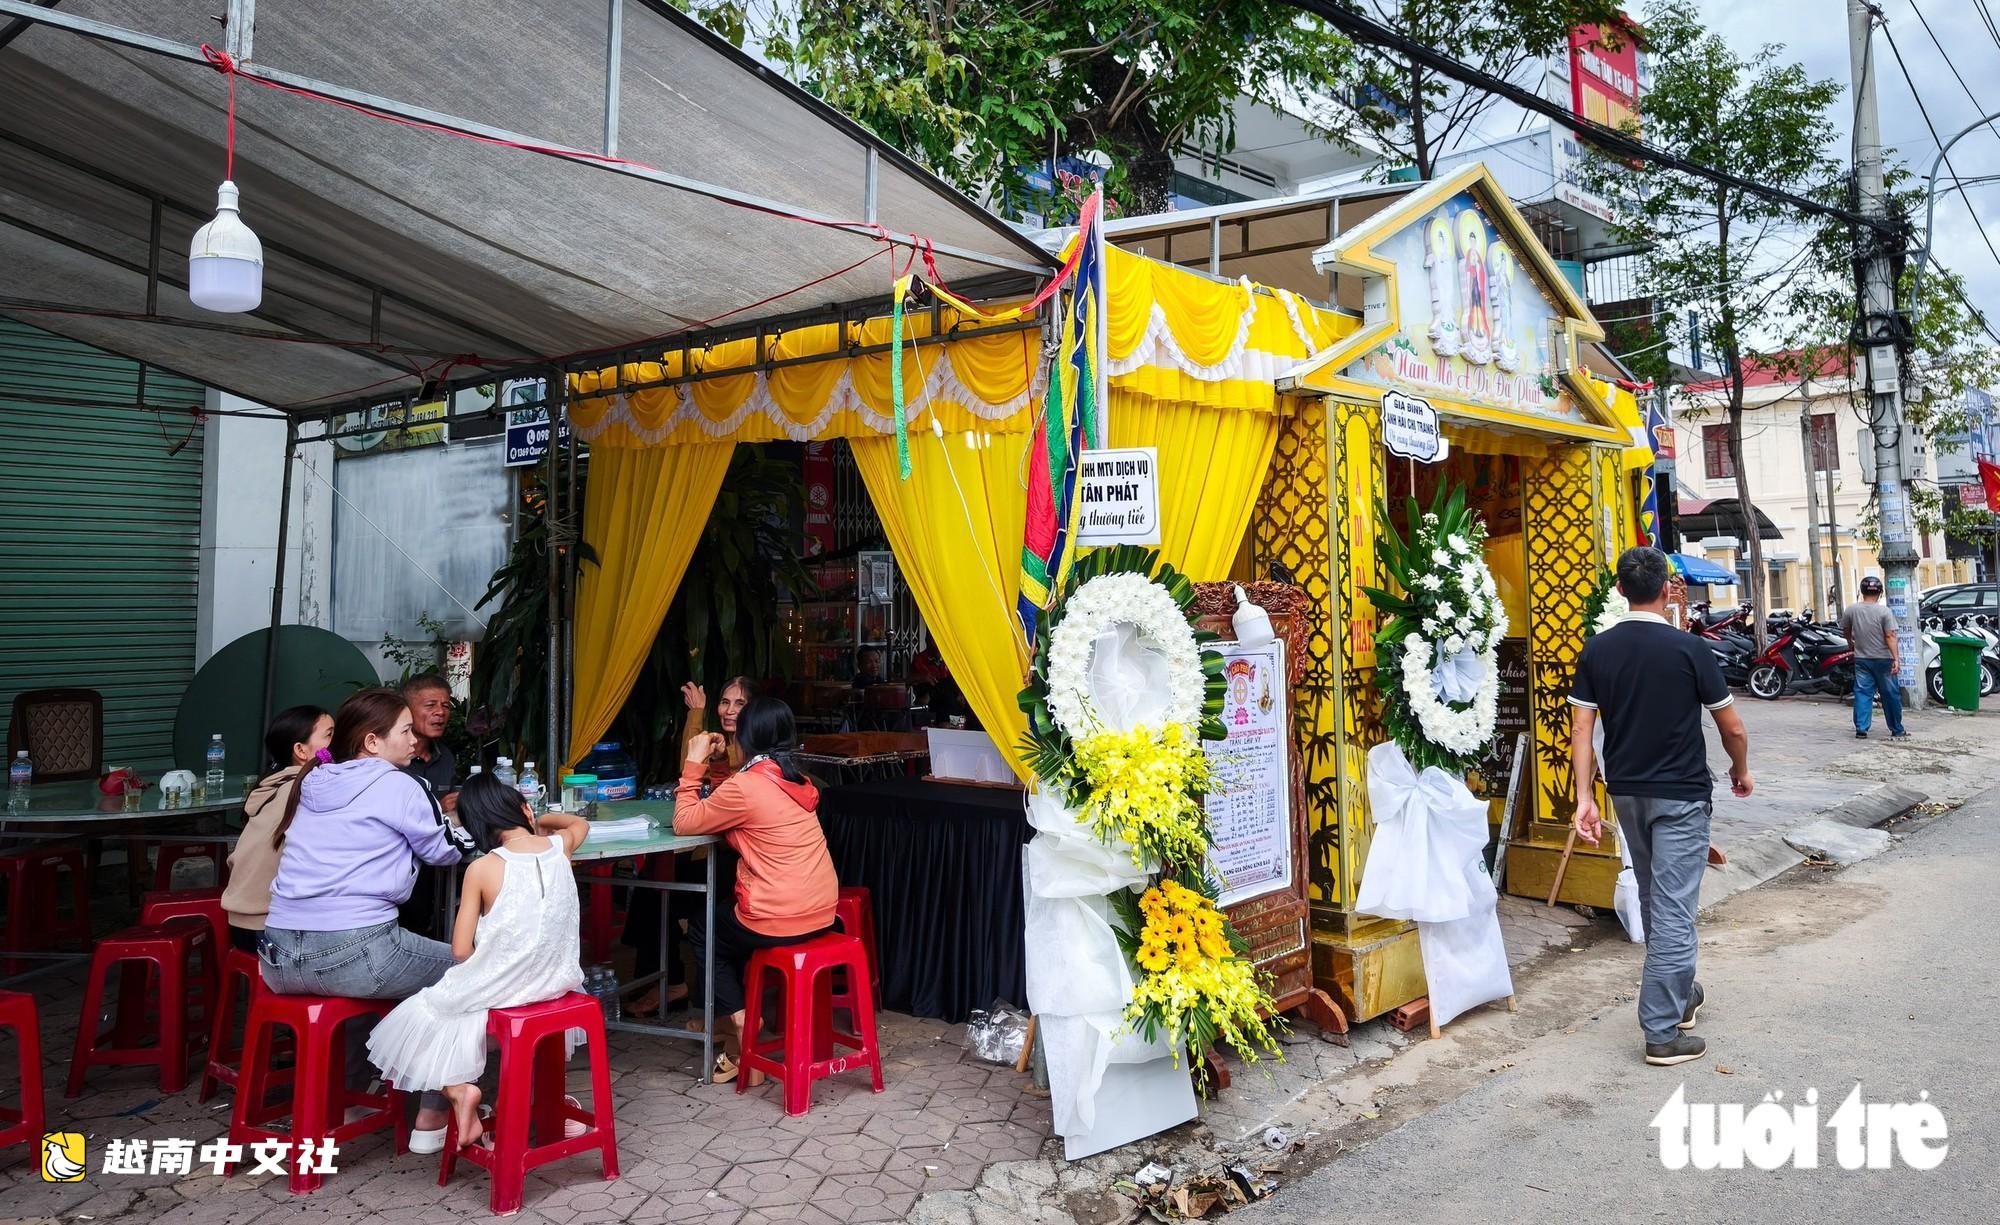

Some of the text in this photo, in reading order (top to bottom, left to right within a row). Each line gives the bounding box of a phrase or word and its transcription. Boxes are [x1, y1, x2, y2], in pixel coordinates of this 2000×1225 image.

[1393, 347, 1428, 380] Nam
[1457, 364, 1470, 390] A
[1394, 399, 1406, 411] GIA
[1097, 462, 1114, 478] MTV
[1116, 460, 1136, 480] DỊCH
[1138, 460, 1148, 478] VỤ
[1106, 481, 1139, 502] PHÁT
